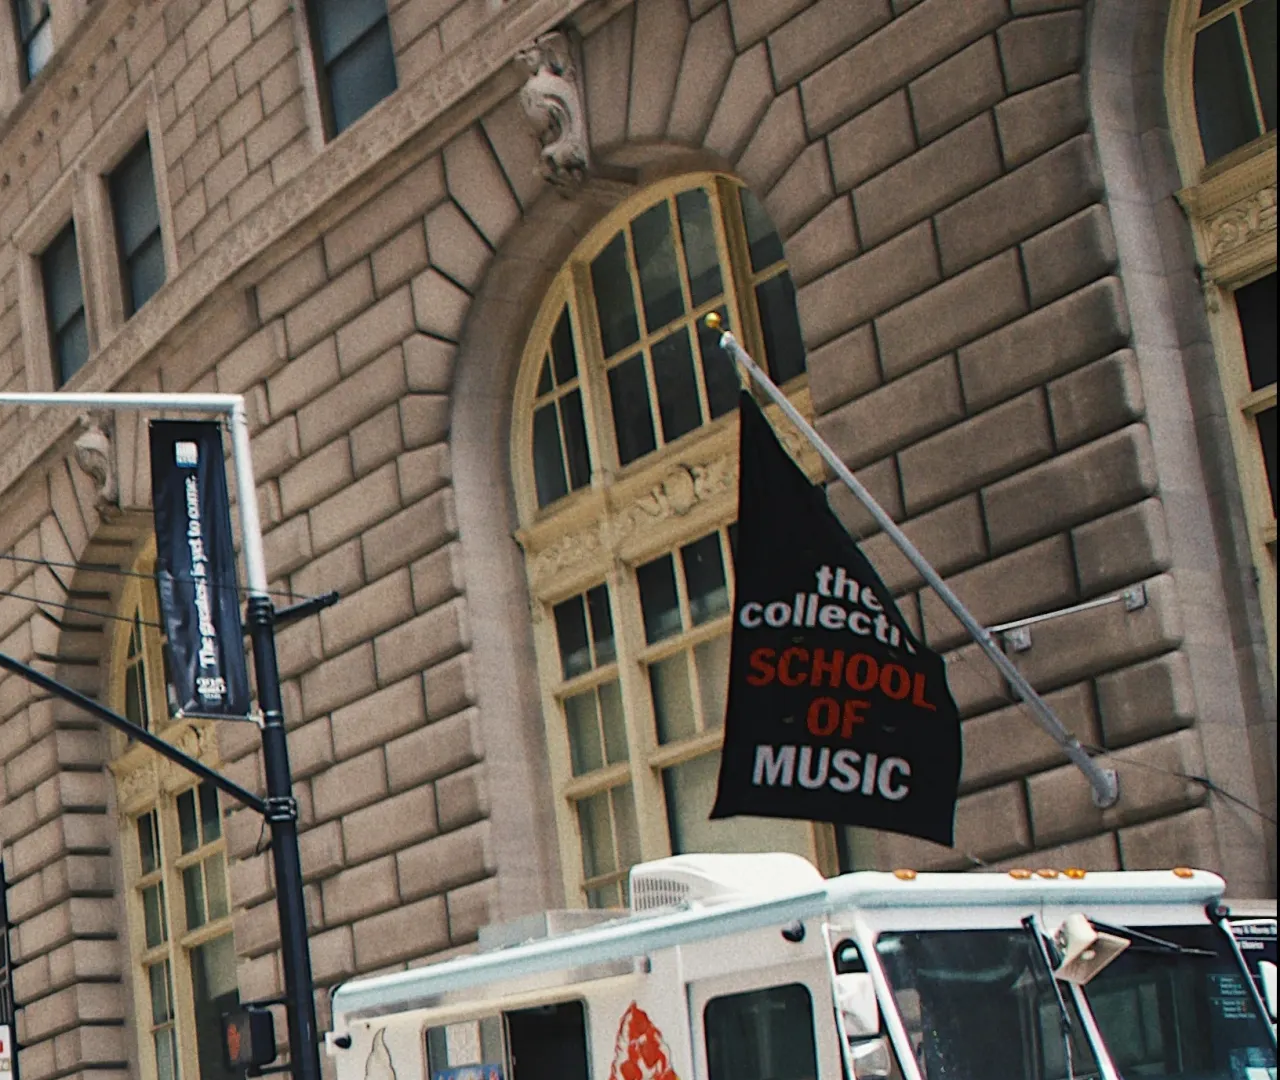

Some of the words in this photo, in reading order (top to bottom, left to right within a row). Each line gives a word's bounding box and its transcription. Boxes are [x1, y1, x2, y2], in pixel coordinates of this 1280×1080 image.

[816, 565, 884, 611] the
[746, 647, 937, 712] SCHOOL
[806, 696, 871, 739] OF
[751, 744, 911, 801] MUSIC
